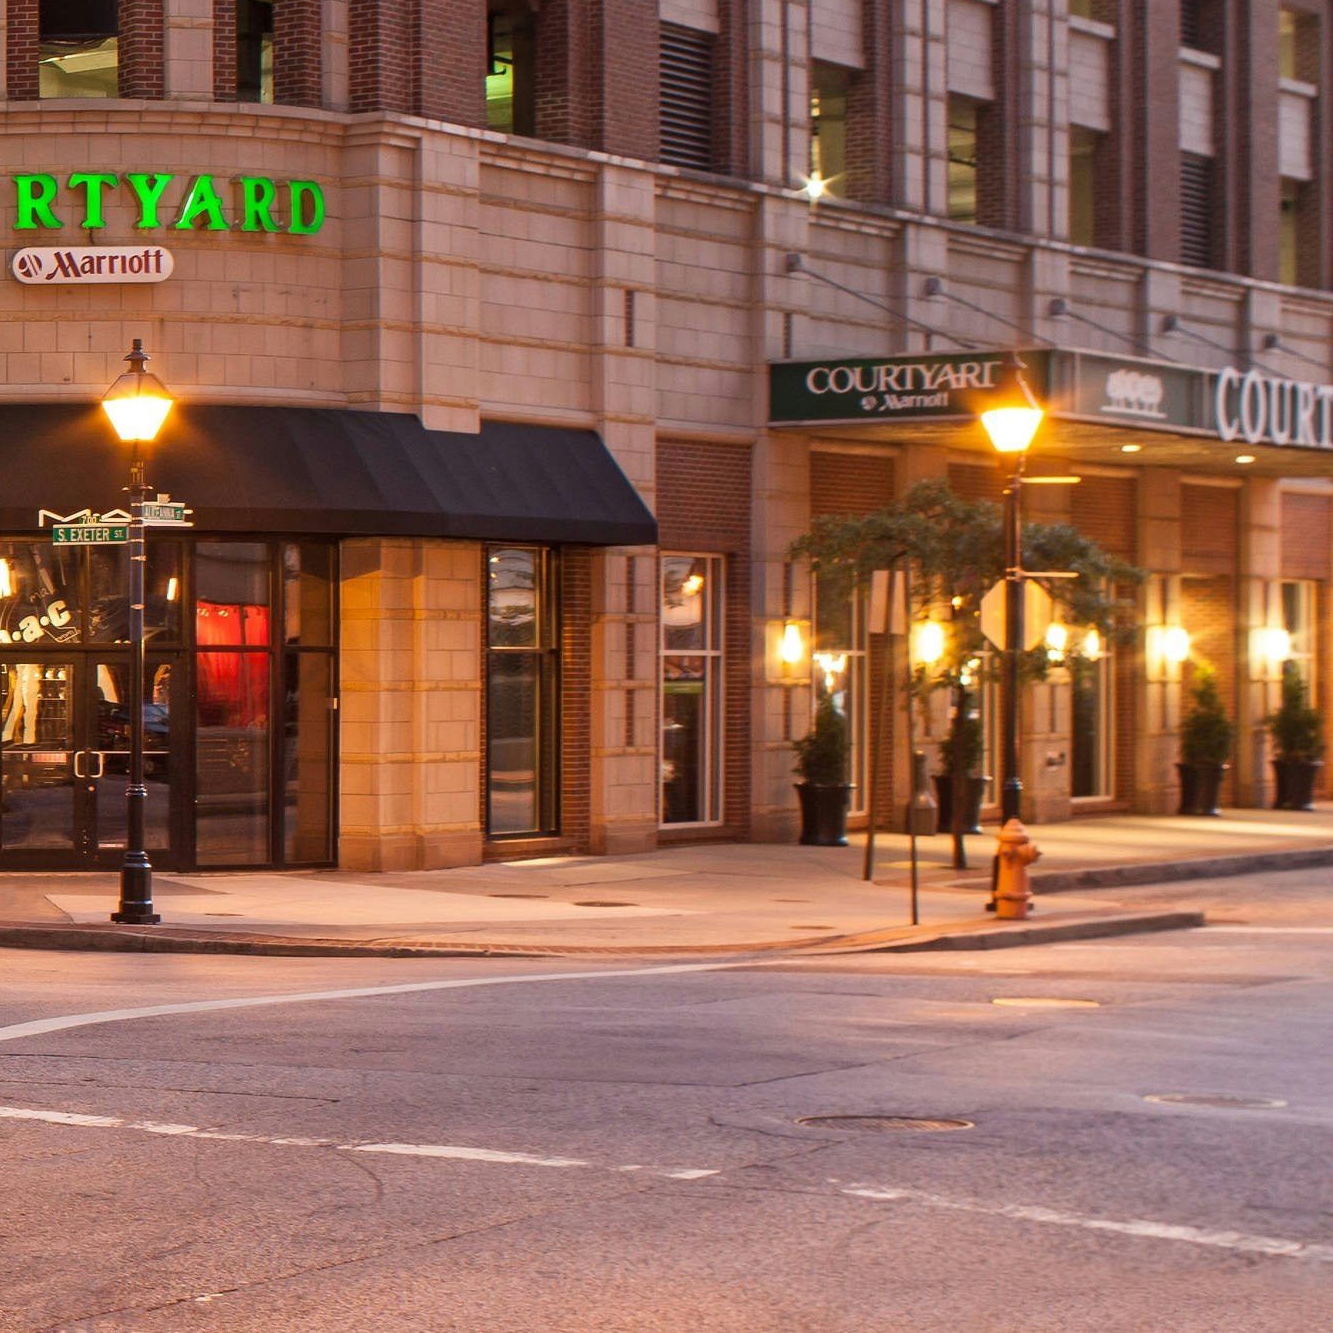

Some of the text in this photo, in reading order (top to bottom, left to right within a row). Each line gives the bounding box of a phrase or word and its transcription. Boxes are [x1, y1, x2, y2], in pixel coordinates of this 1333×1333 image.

[45, 249, 164, 281] Marriott
[878, 392, 949, 411] Marriott
[1216, 365, 1333, 449] COURT
[58, 528, 124, 542] S. EXETER ST.
